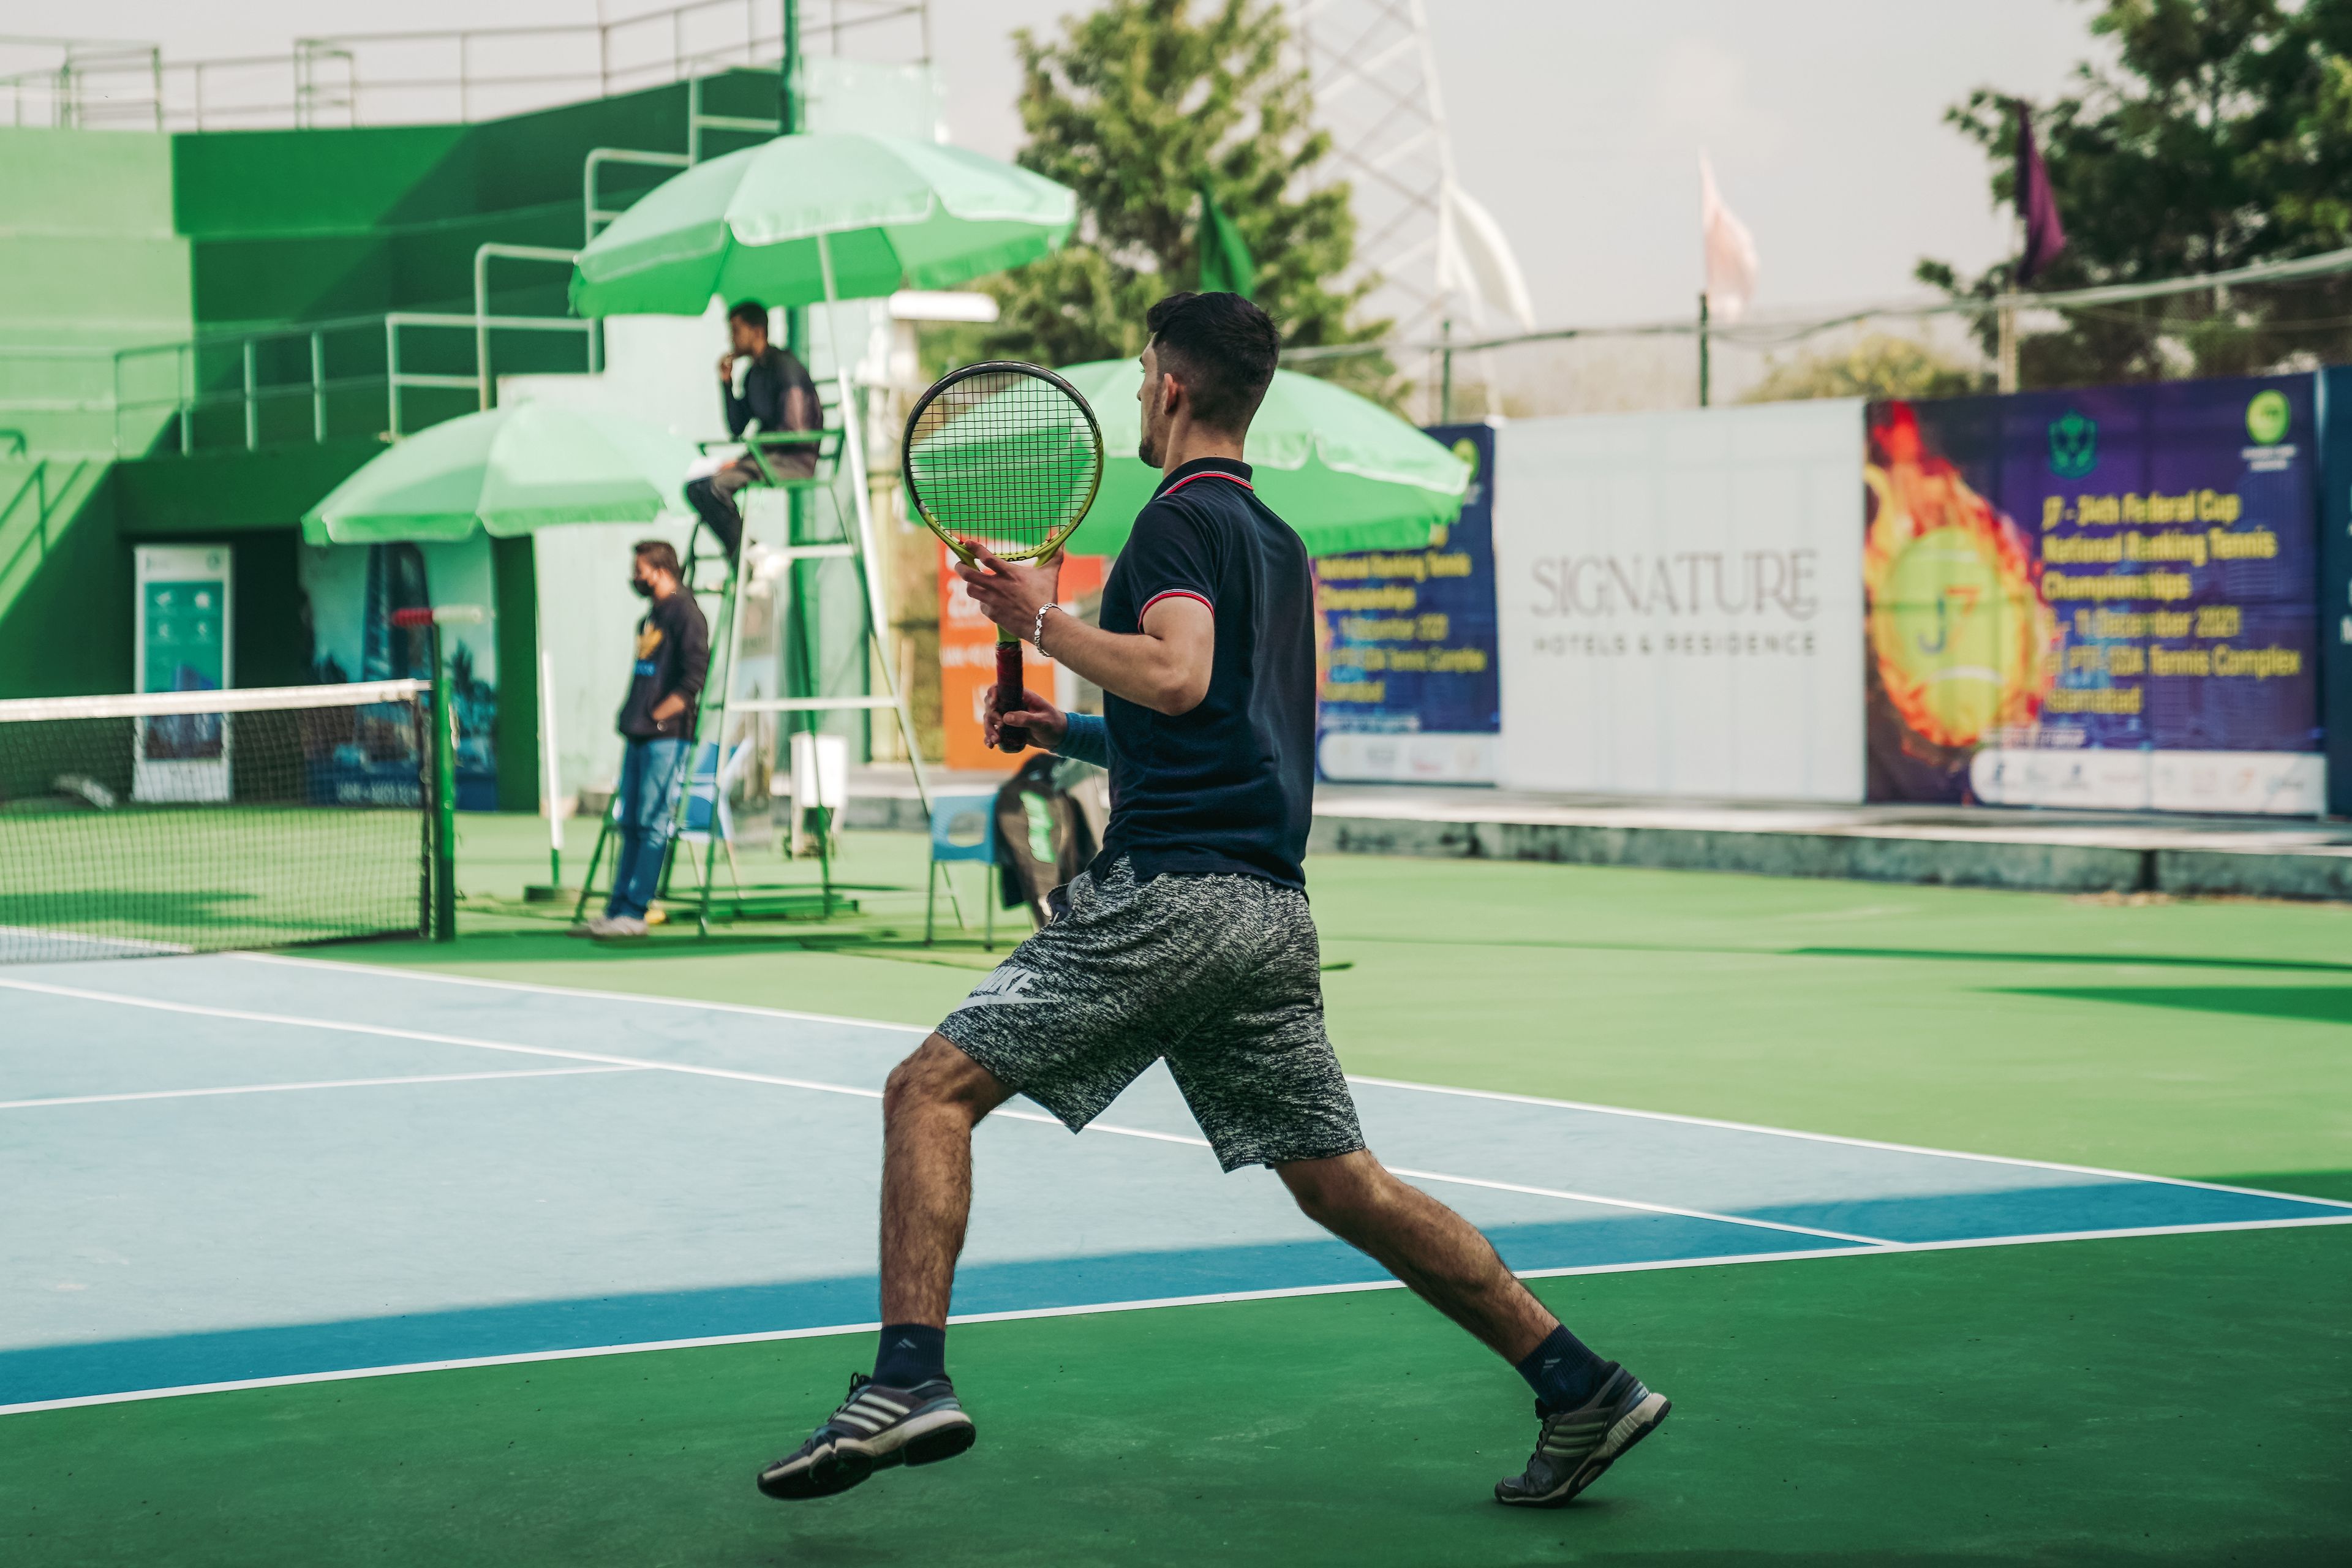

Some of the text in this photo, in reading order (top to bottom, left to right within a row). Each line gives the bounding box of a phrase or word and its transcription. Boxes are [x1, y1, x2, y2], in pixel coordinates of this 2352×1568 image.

[2122, 490, 2196, 523] Federal
[2198, 489, 2241, 526] Cup
[2042, 526, 2278, 566] National Ranking Tennis
[1530, 548, 1820, 622] SIGNATURE
[2041, 568, 2192, 602] Championships
[2094, 608, 2191, 638] December
[1533, 630, 1815, 657] HOTELS & RESIDENCE
[2149, 643, 2210, 676] Tennis
[2212, 643, 2301, 680] Complex
